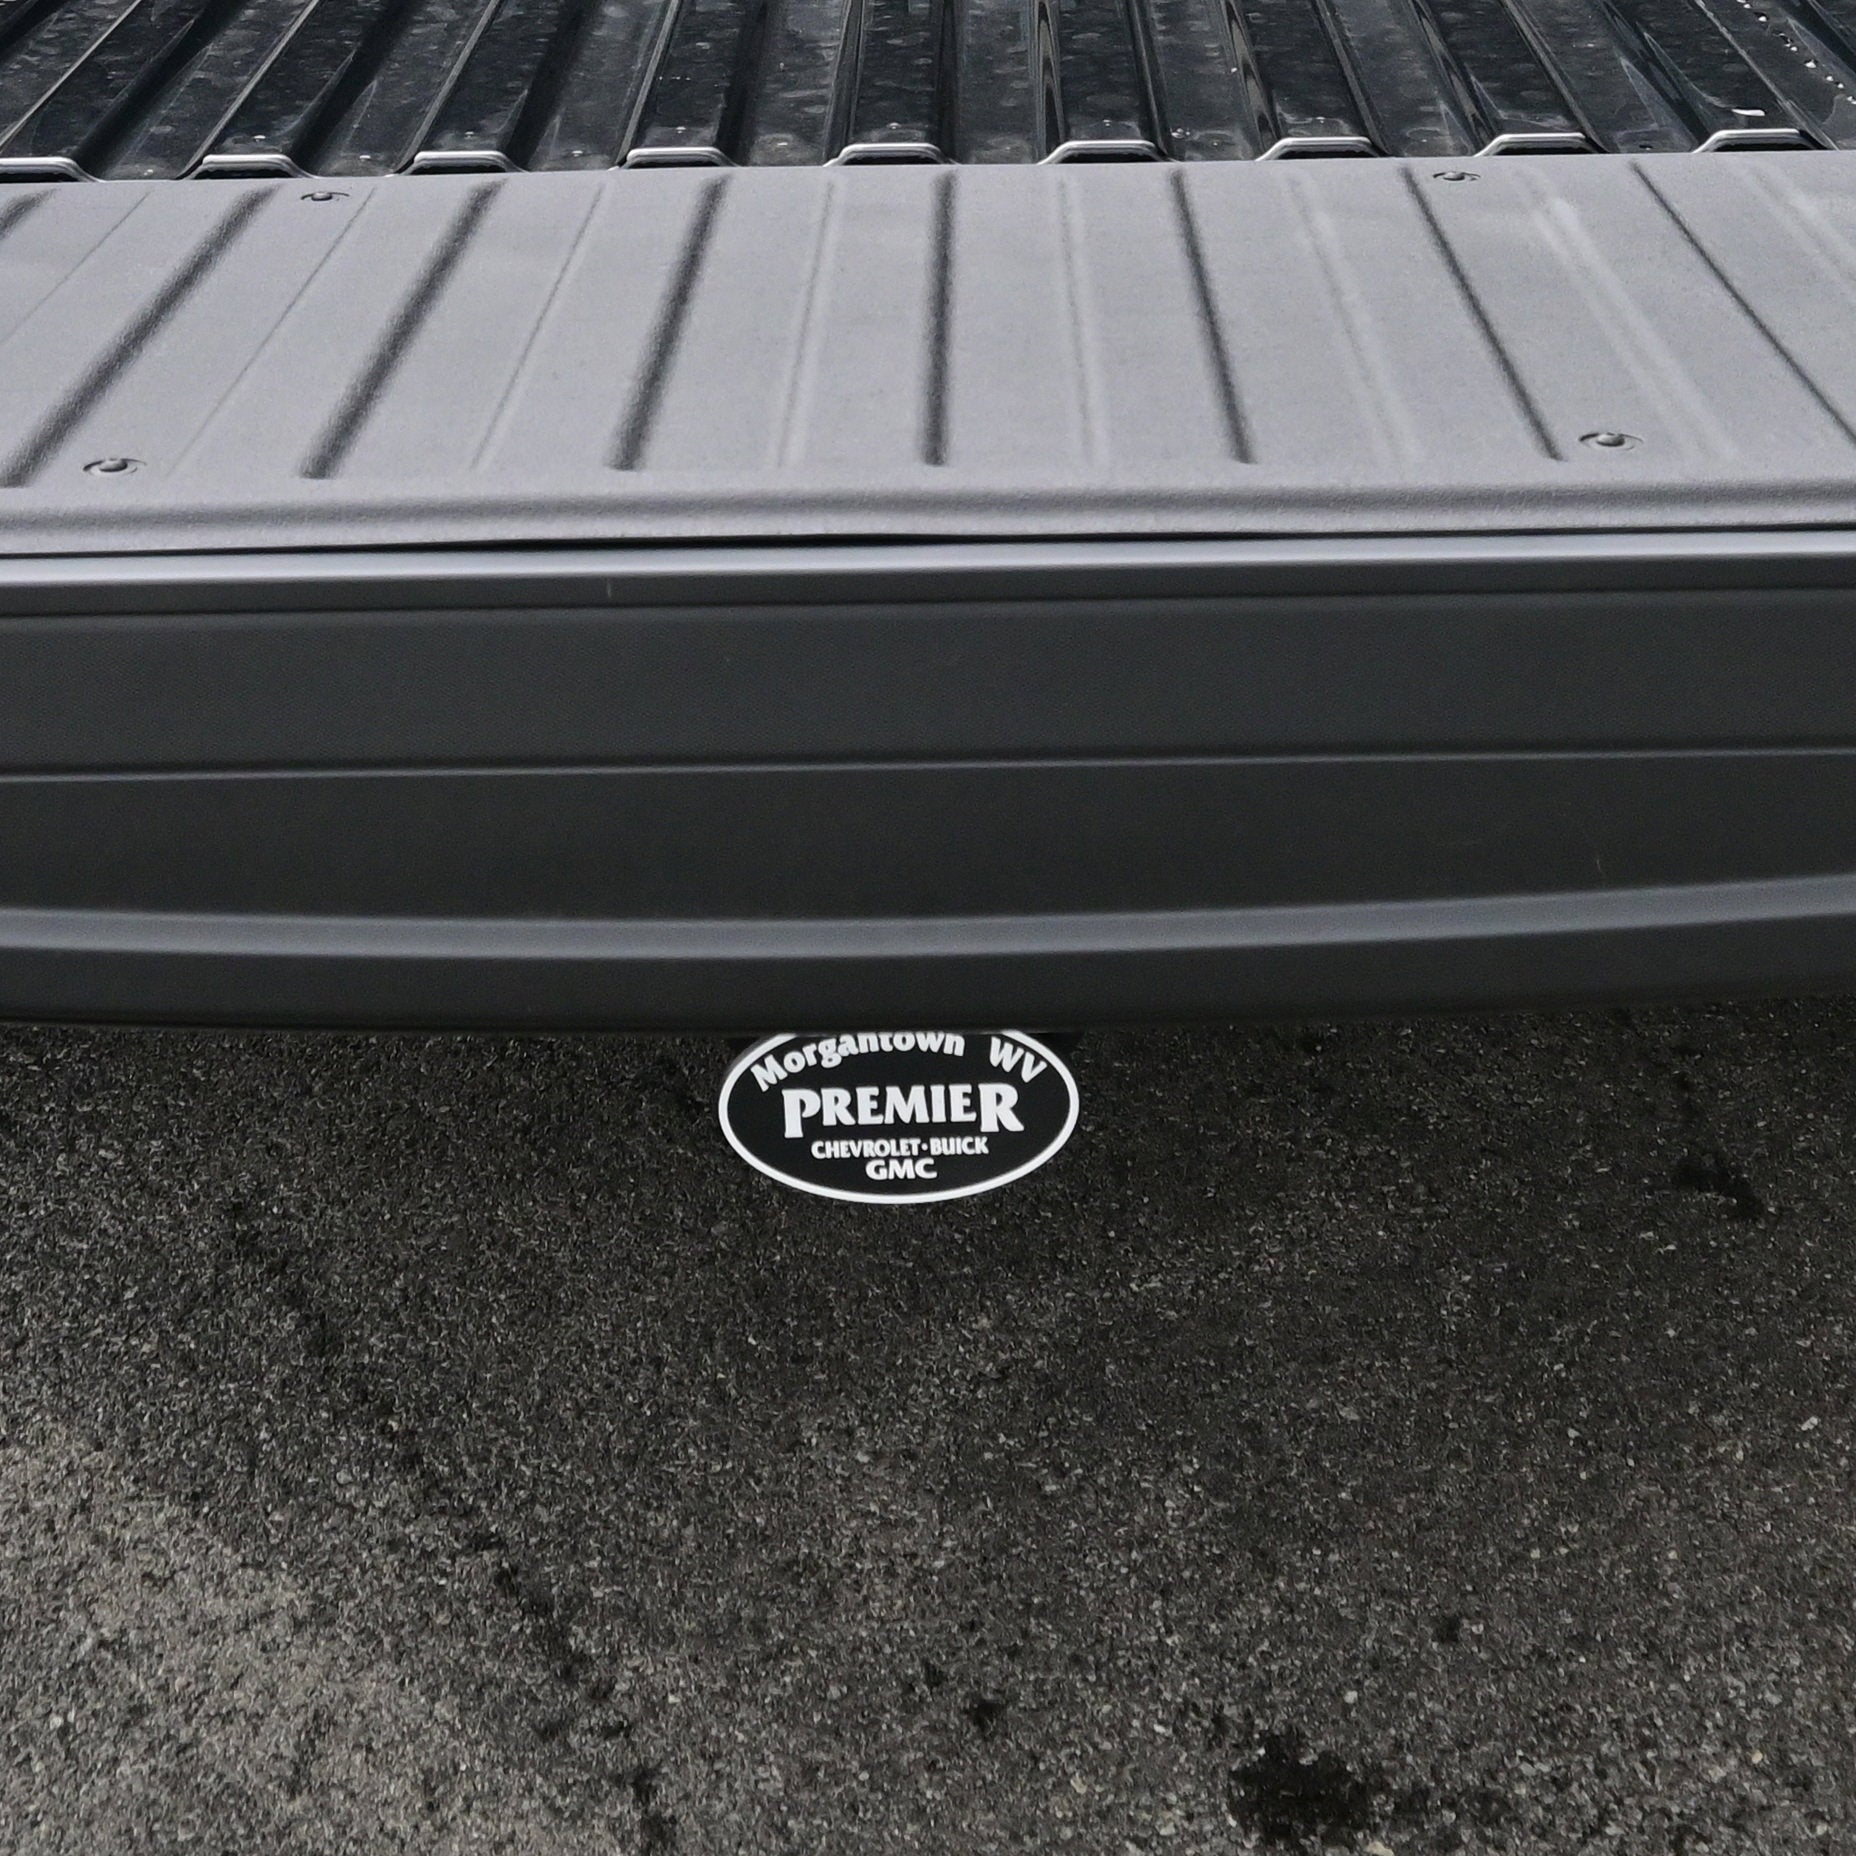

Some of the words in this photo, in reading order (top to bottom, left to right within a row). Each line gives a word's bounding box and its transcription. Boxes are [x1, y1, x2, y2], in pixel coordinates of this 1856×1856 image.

[750, 1033, 966, 1092] Morgantown
[989, 1037, 1047, 1084] WV
[782, 1083, 1025, 1139] PREMIER
[865, 1158, 938, 1181] GMC
